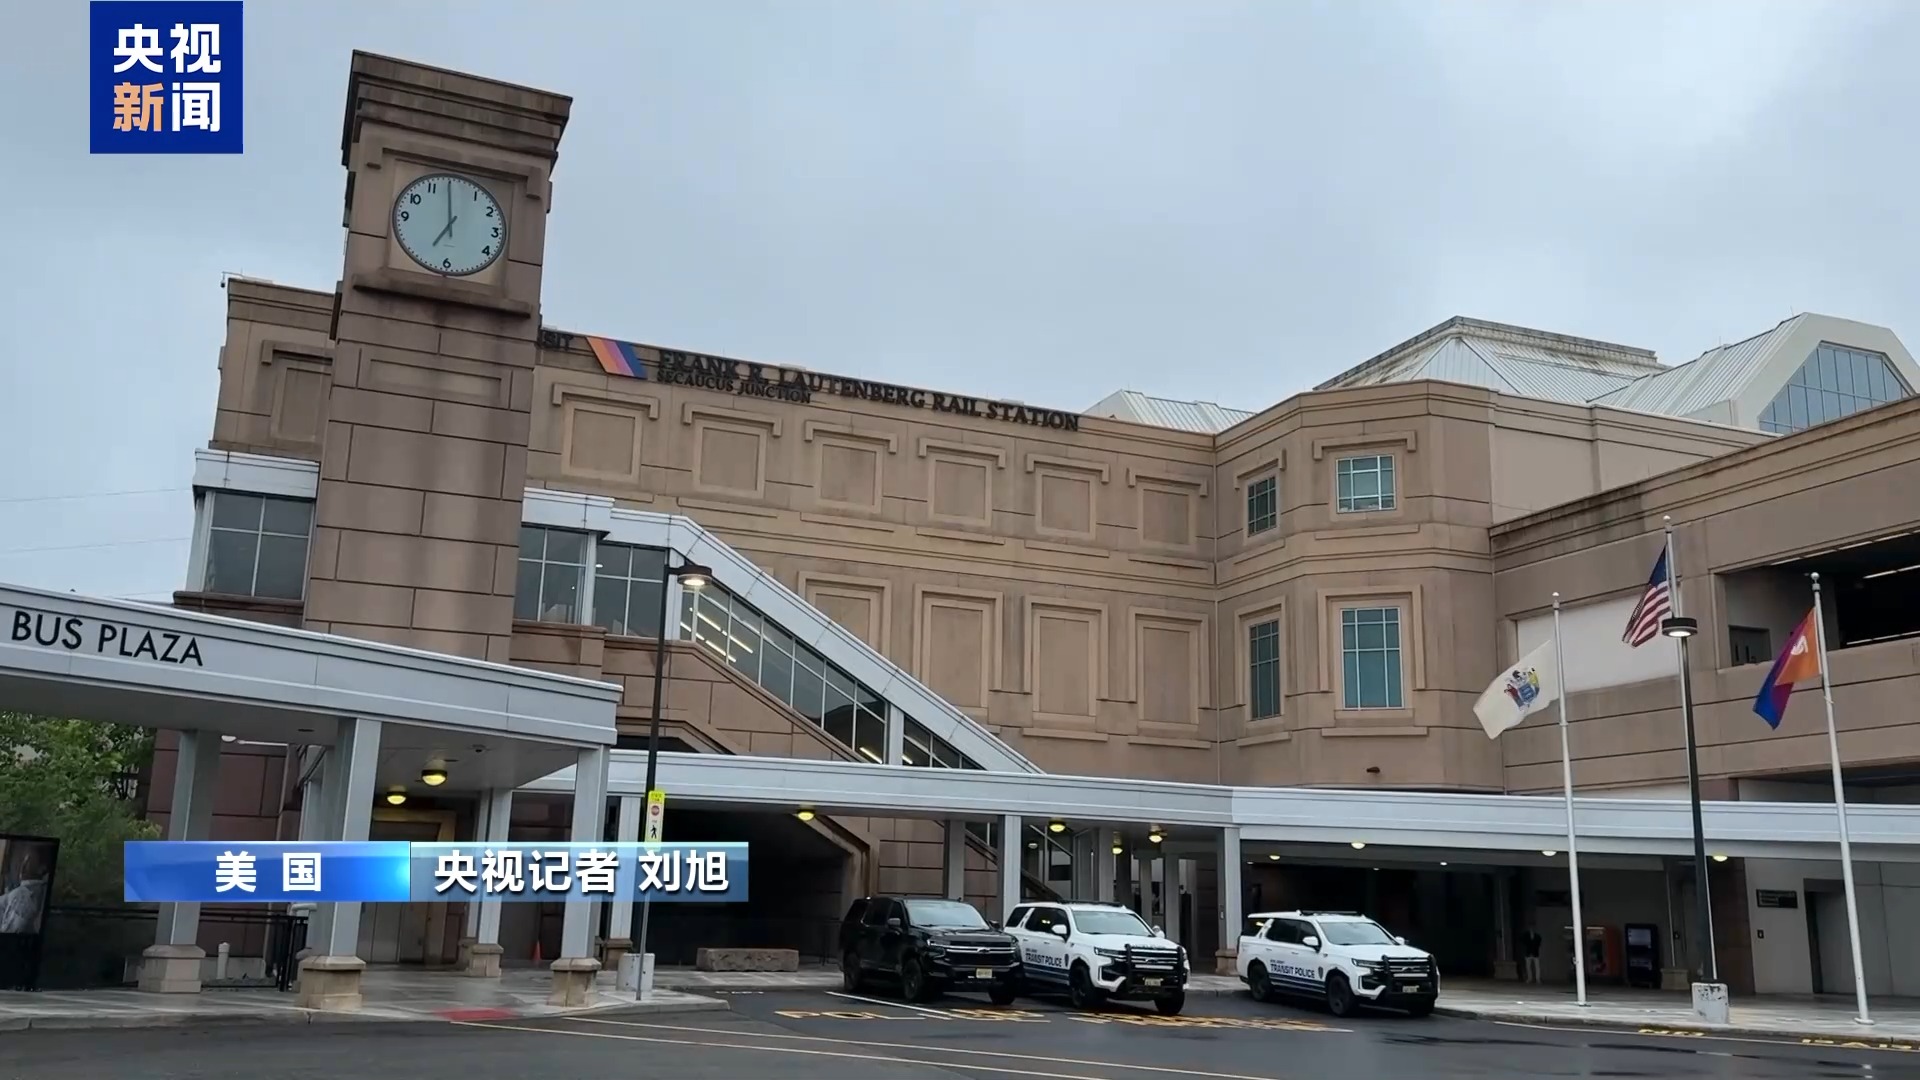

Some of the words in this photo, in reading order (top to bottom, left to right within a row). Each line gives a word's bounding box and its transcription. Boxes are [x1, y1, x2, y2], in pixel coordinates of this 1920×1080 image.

[428, 183, 436, 194] 11
[410, 194, 421, 205] 10
[401, 211, 409, 221] 9
[486, 206, 494, 217] 2
[491, 227, 499, 238] 3
[482, 245, 490, 256] 4
[442, 258, 451, 268] 6
[657, 368, 734, 392] SECAUCUS
[737, 380, 811, 404] JUNCTION
[659, 350, 739, 379] FRANK
[778, 368, 925, 408] LAUTENBERG
[932, 392, 981, 417] RAIL
[987, 402, 1079, 431] STATION
[11, 610, 83, 650] BUS
[98, 624, 203, 667] PLAZA
[1295, 967, 1315, 978] POLICE
